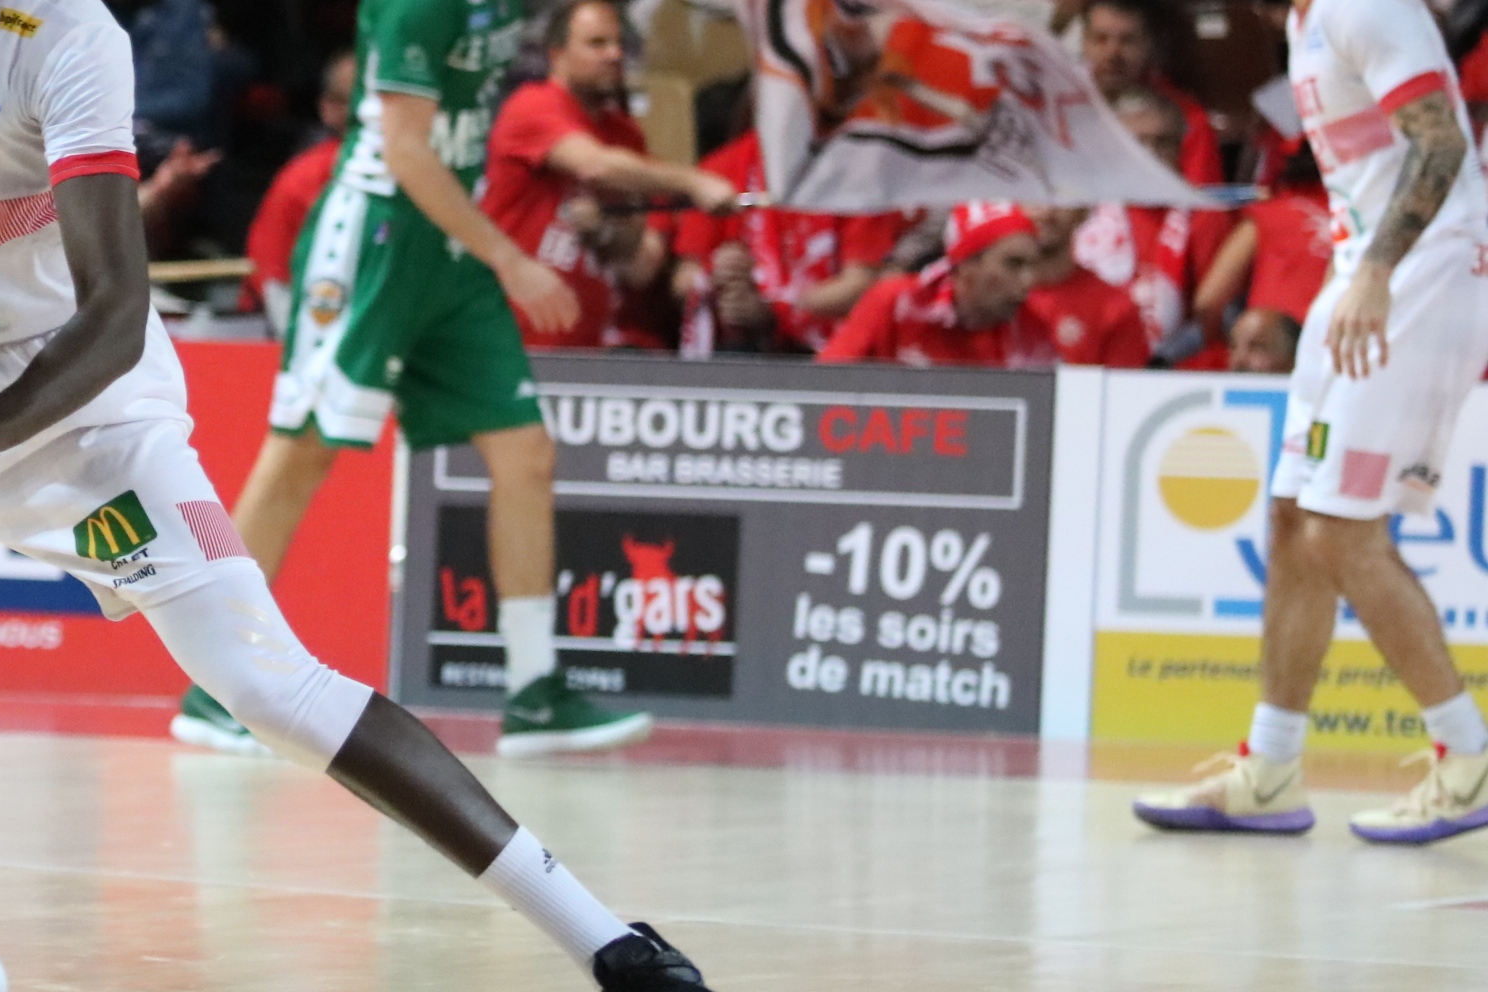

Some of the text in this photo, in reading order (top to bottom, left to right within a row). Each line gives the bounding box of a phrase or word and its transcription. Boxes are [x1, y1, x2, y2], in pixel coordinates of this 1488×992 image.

[817, 404, 969, 456] CAFE
[607, 451, 844, 489] BAR BRASSERIE
[113, 563, 157, 589] SPALDING
[803, 520, 1003, 610] -10%
[793, 591, 1000, 659] les soirs
[785, 642, 1012, 710] de match
